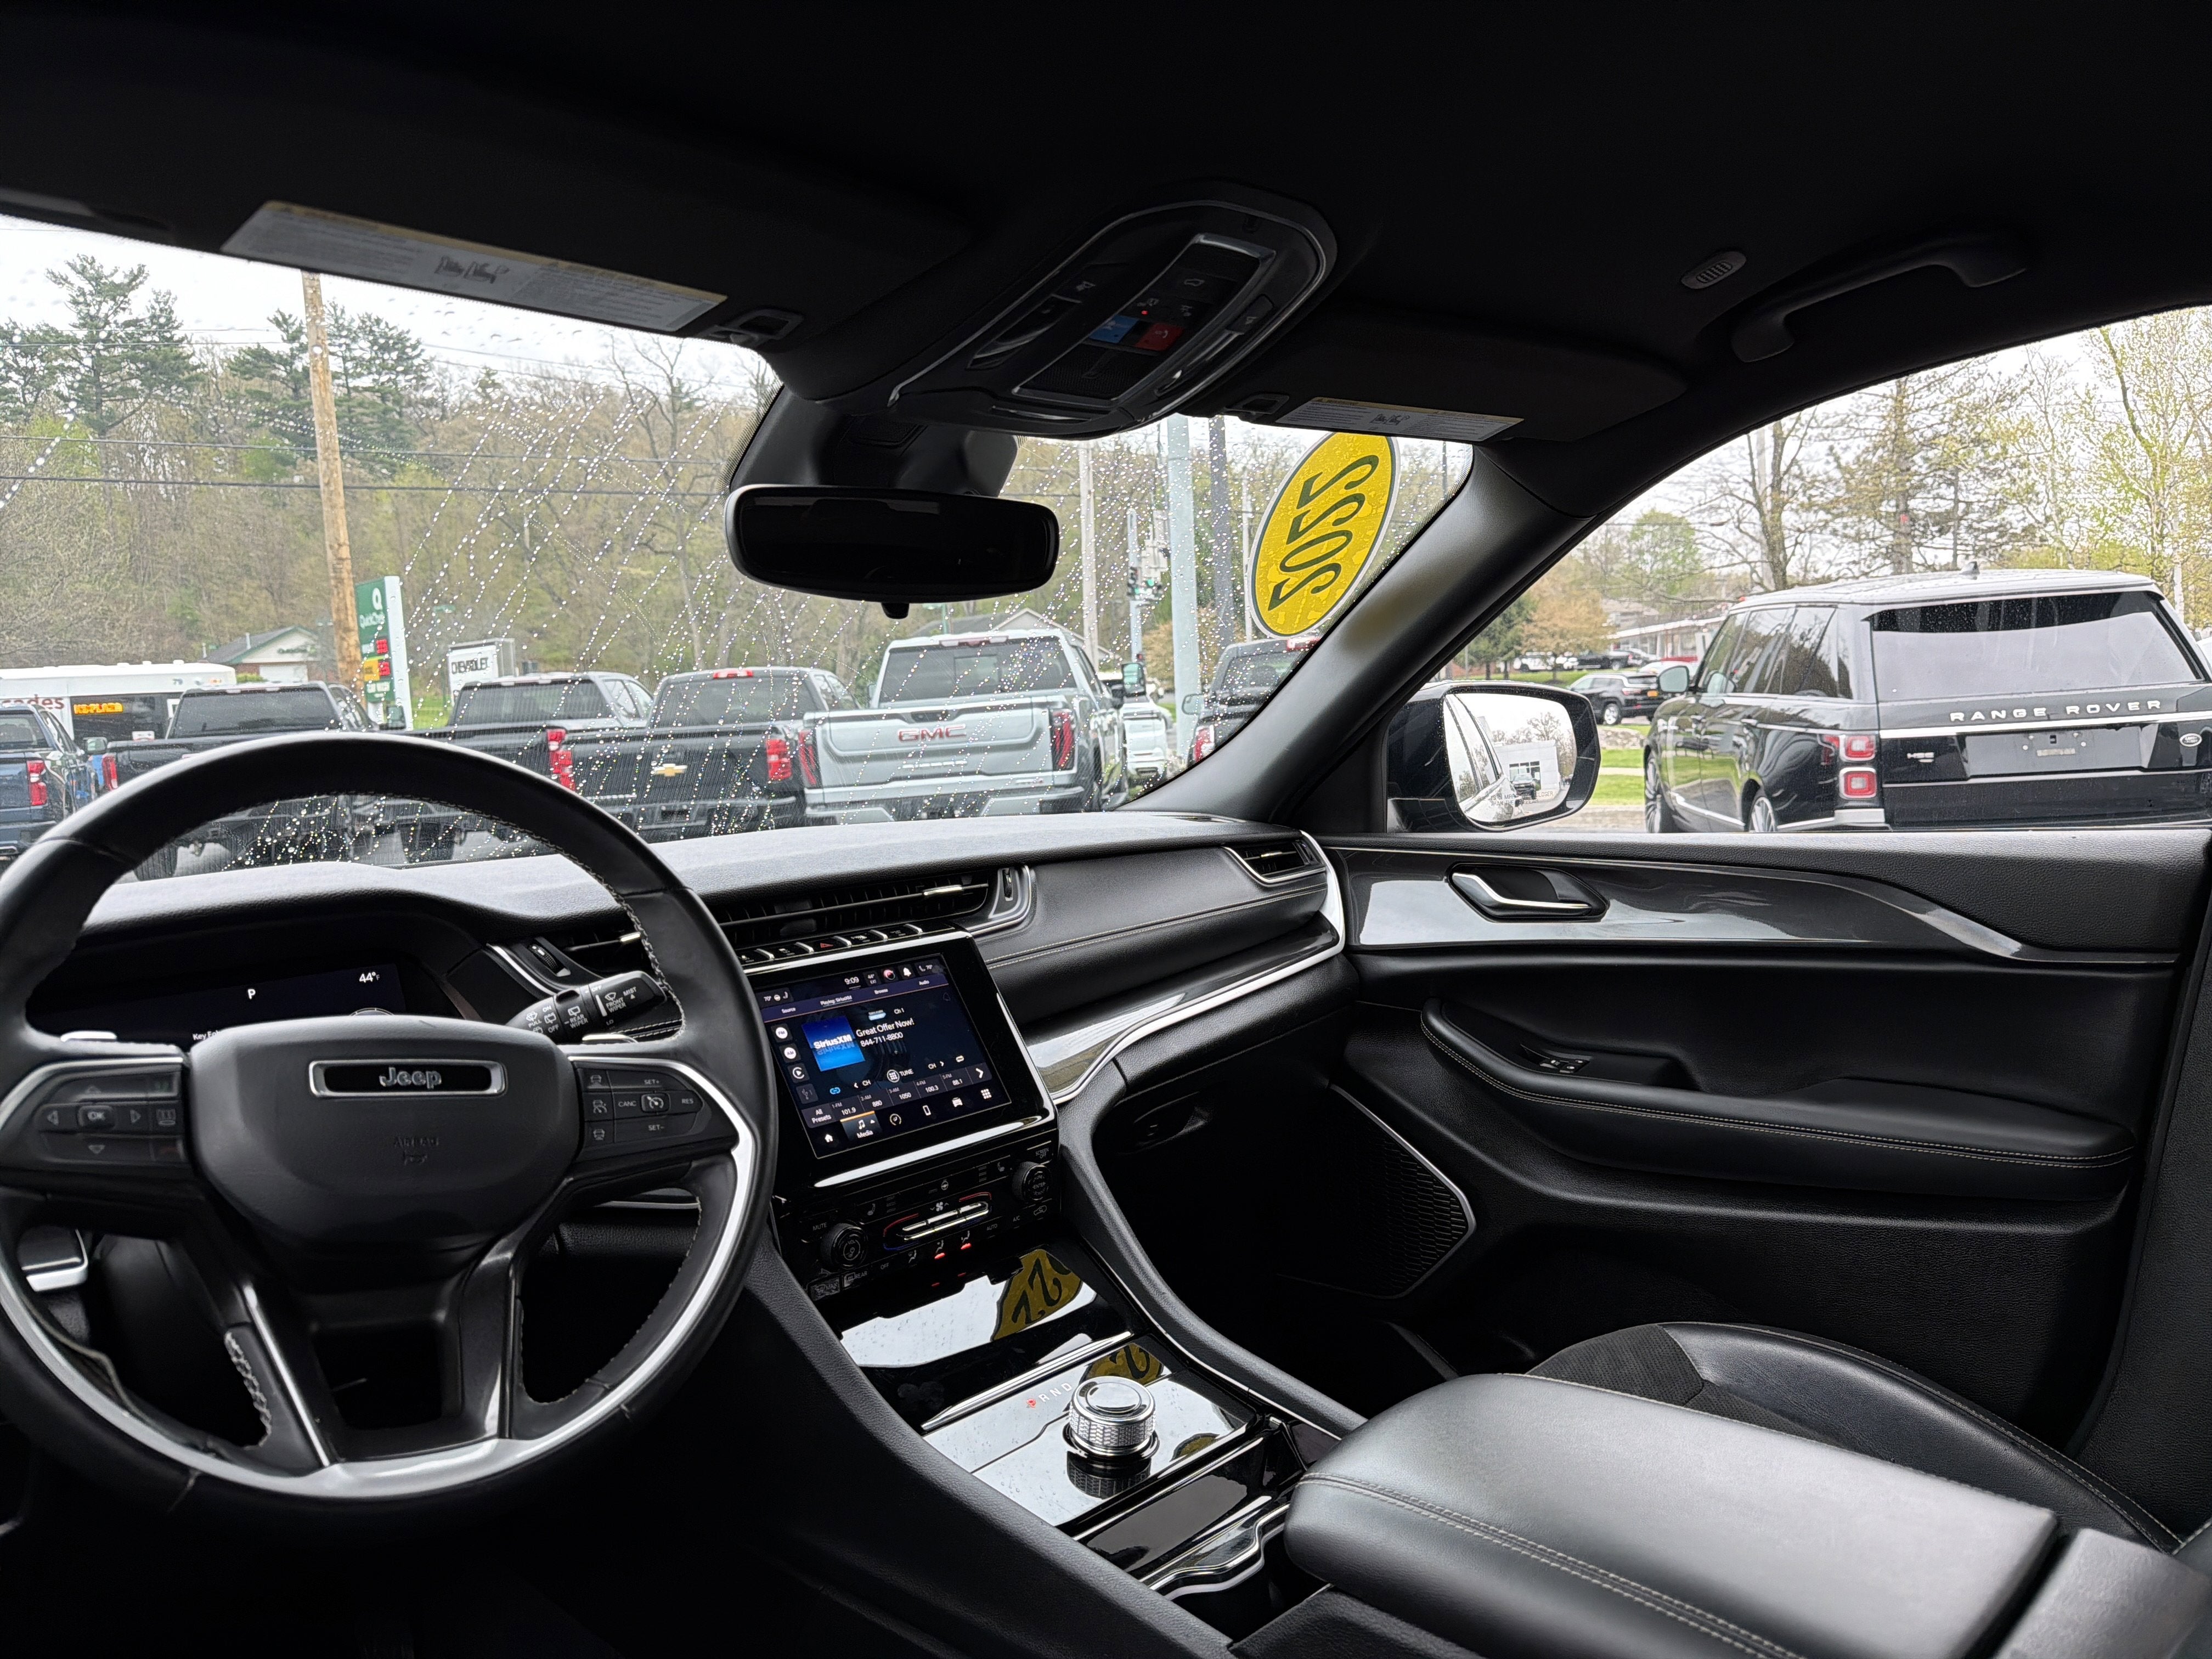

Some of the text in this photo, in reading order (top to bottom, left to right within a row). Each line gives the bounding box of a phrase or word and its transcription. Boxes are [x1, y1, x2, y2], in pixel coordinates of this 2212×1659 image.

[373, 588, 382, 610] Q
[1950, 701, 2160, 721] RANGE ROVER
[898, 724, 966, 741] GMC
[844, 977, 860, 985] 9:09
[248, 989, 256, 999] P
[623, 986, 636, 996] MIST
[606, 997, 624, 1007] FRONT
[608, 1002, 627, 1013] WIPER
[569, 1014, 584, 1023] REAR
[549, 1024, 559, 1032] OFF
[569, 1019, 588, 1029] WIPER
[856, 1018, 915, 1037] Great Offer Now!
[193, 1033, 206, 1041] Key
[814, 1034, 853, 1049] SiriusXM
[860, 1031, 903, 1047] 844-711-8800
[899, 1068, 914, 1076] TUNE
[379, 1067, 442, 1089] Jeep
[87, 1111, 105, 1121] OK
[841, 1107, 856, 1115] 101.9
[811, 1114, 832, 1124] Presets
[856, 1130, 873, 1138] Media
[812, 1222, 827, 1231] MUTE
[1049, 1388, 1062, 1396] N
[1061, 1383, 1072, 1391] D
